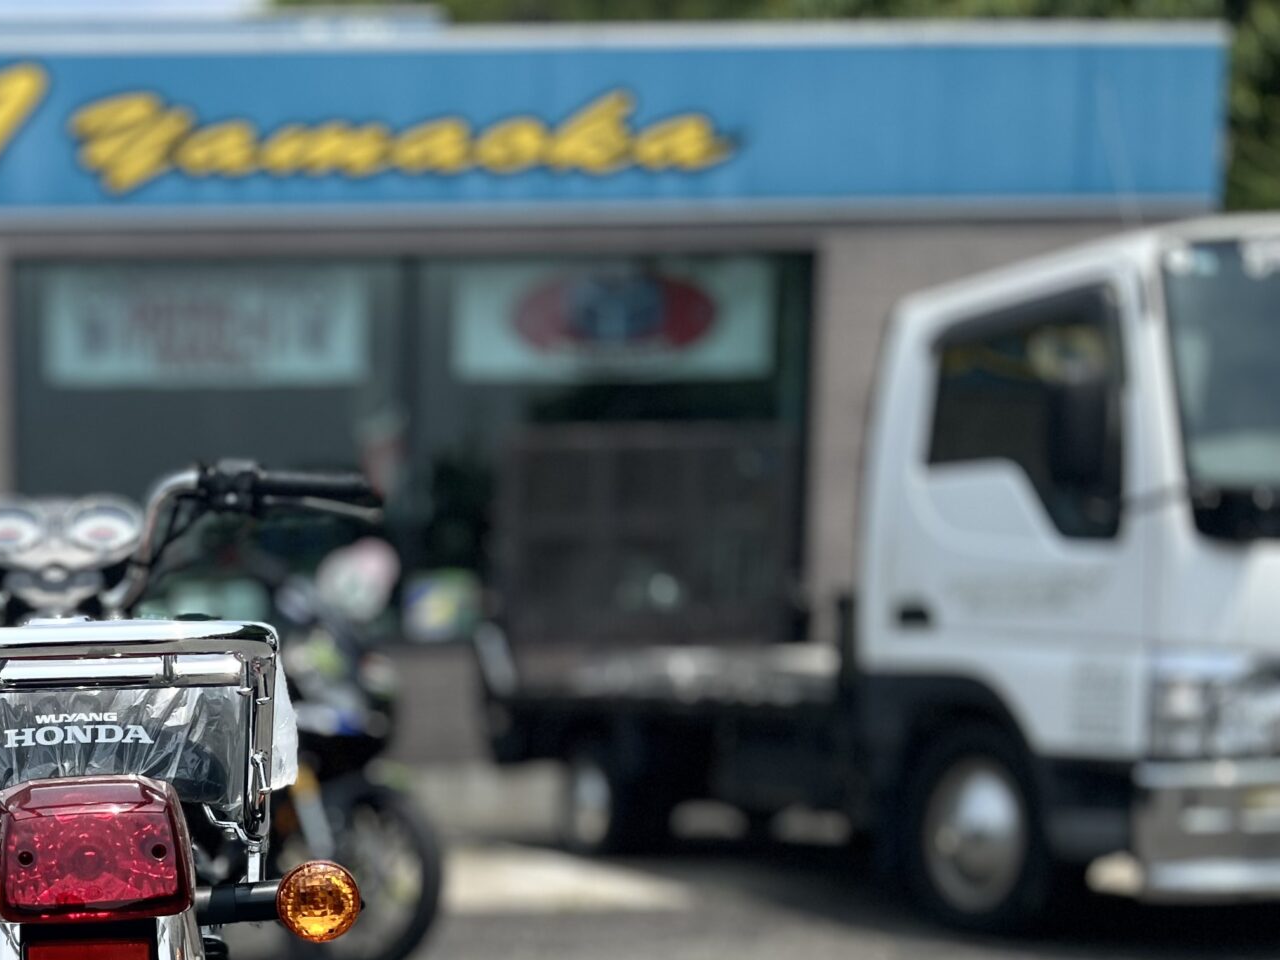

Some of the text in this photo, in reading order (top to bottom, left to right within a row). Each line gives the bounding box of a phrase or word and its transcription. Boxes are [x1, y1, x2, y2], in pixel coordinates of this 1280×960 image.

[70, 88, 743, 195] Yamaoka
[35, 712, 118, 724] WUYANG
[3, 724, 155, 748] HONDA
